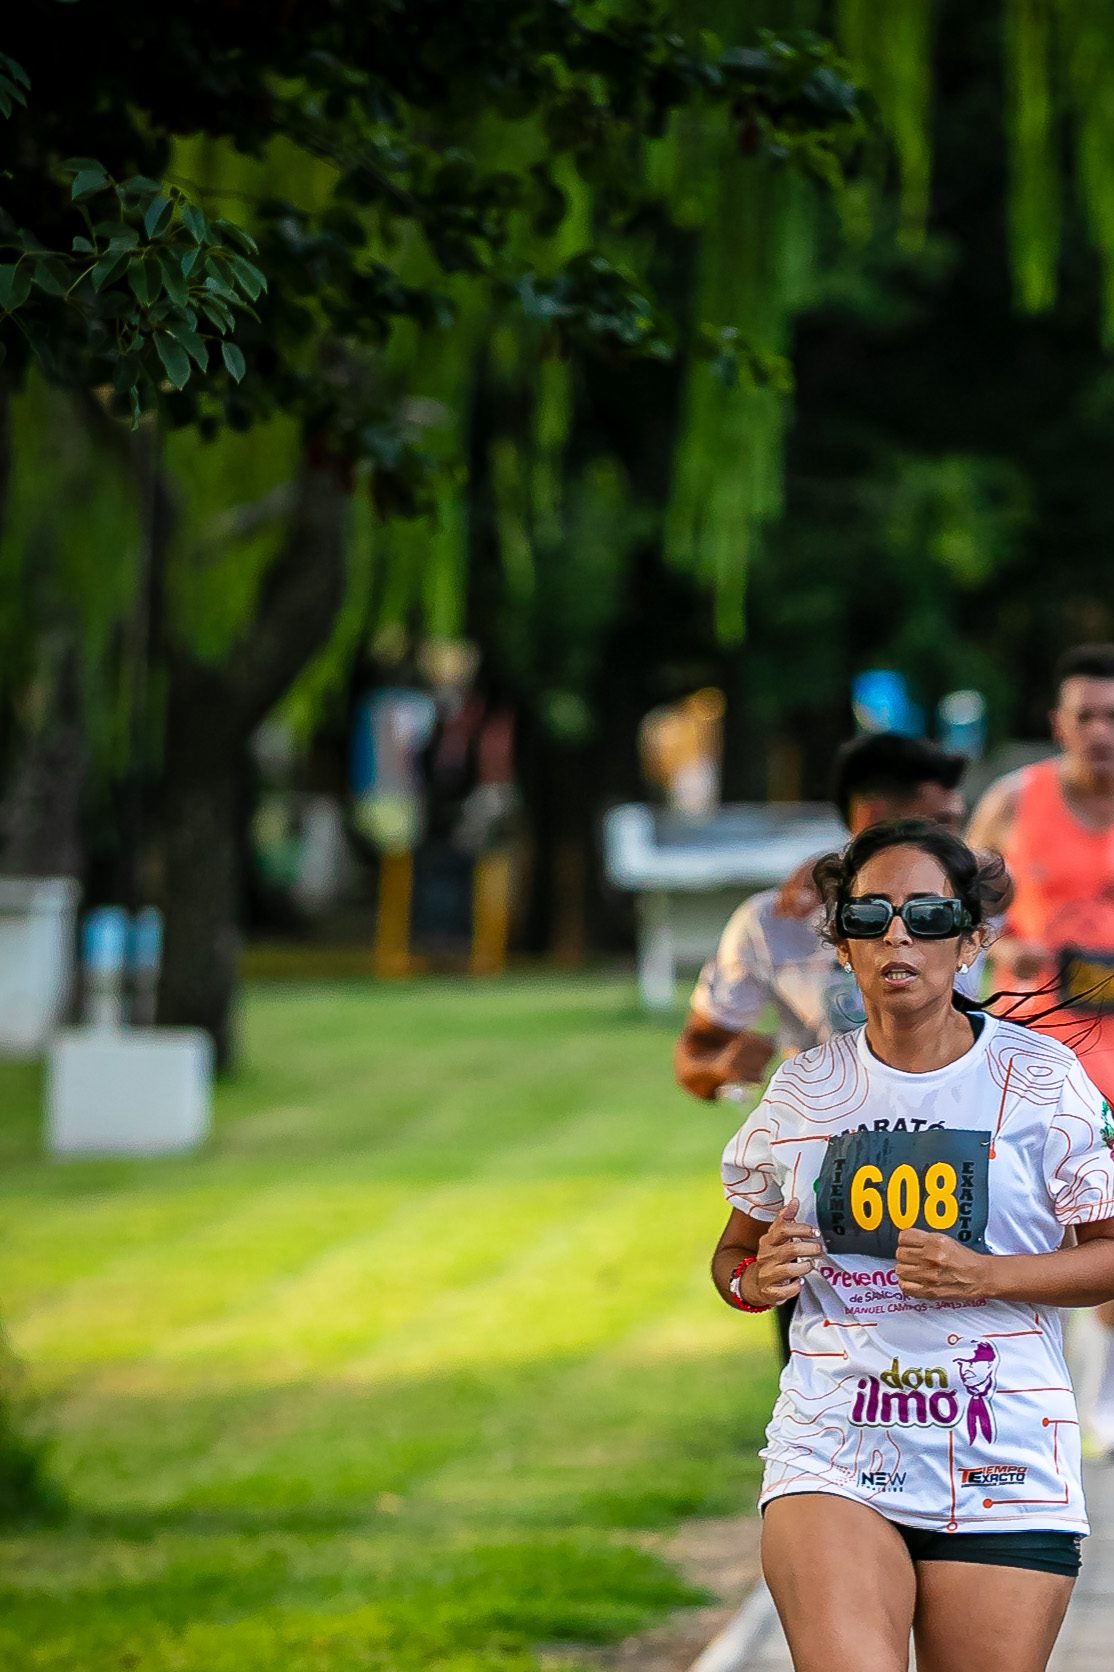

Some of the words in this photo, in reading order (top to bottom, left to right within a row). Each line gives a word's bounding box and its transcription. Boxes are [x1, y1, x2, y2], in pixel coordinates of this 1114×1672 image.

[829, 1158, 846, 1236] TIEMPO
[850, 1161, 959, 1232] 608
[958, 1162, 975, 1242] EXACTO
[844, 1306, 885, 1315] MANUEL
[849, 1293, 863, 1303] de
[880, 1356, 948, 1390] don
[852, 1375, 958, 1423] ilmo
[861, 1471, 907, 1485] NEW
[957, 1465, 1028, 1483] TIEMPO
